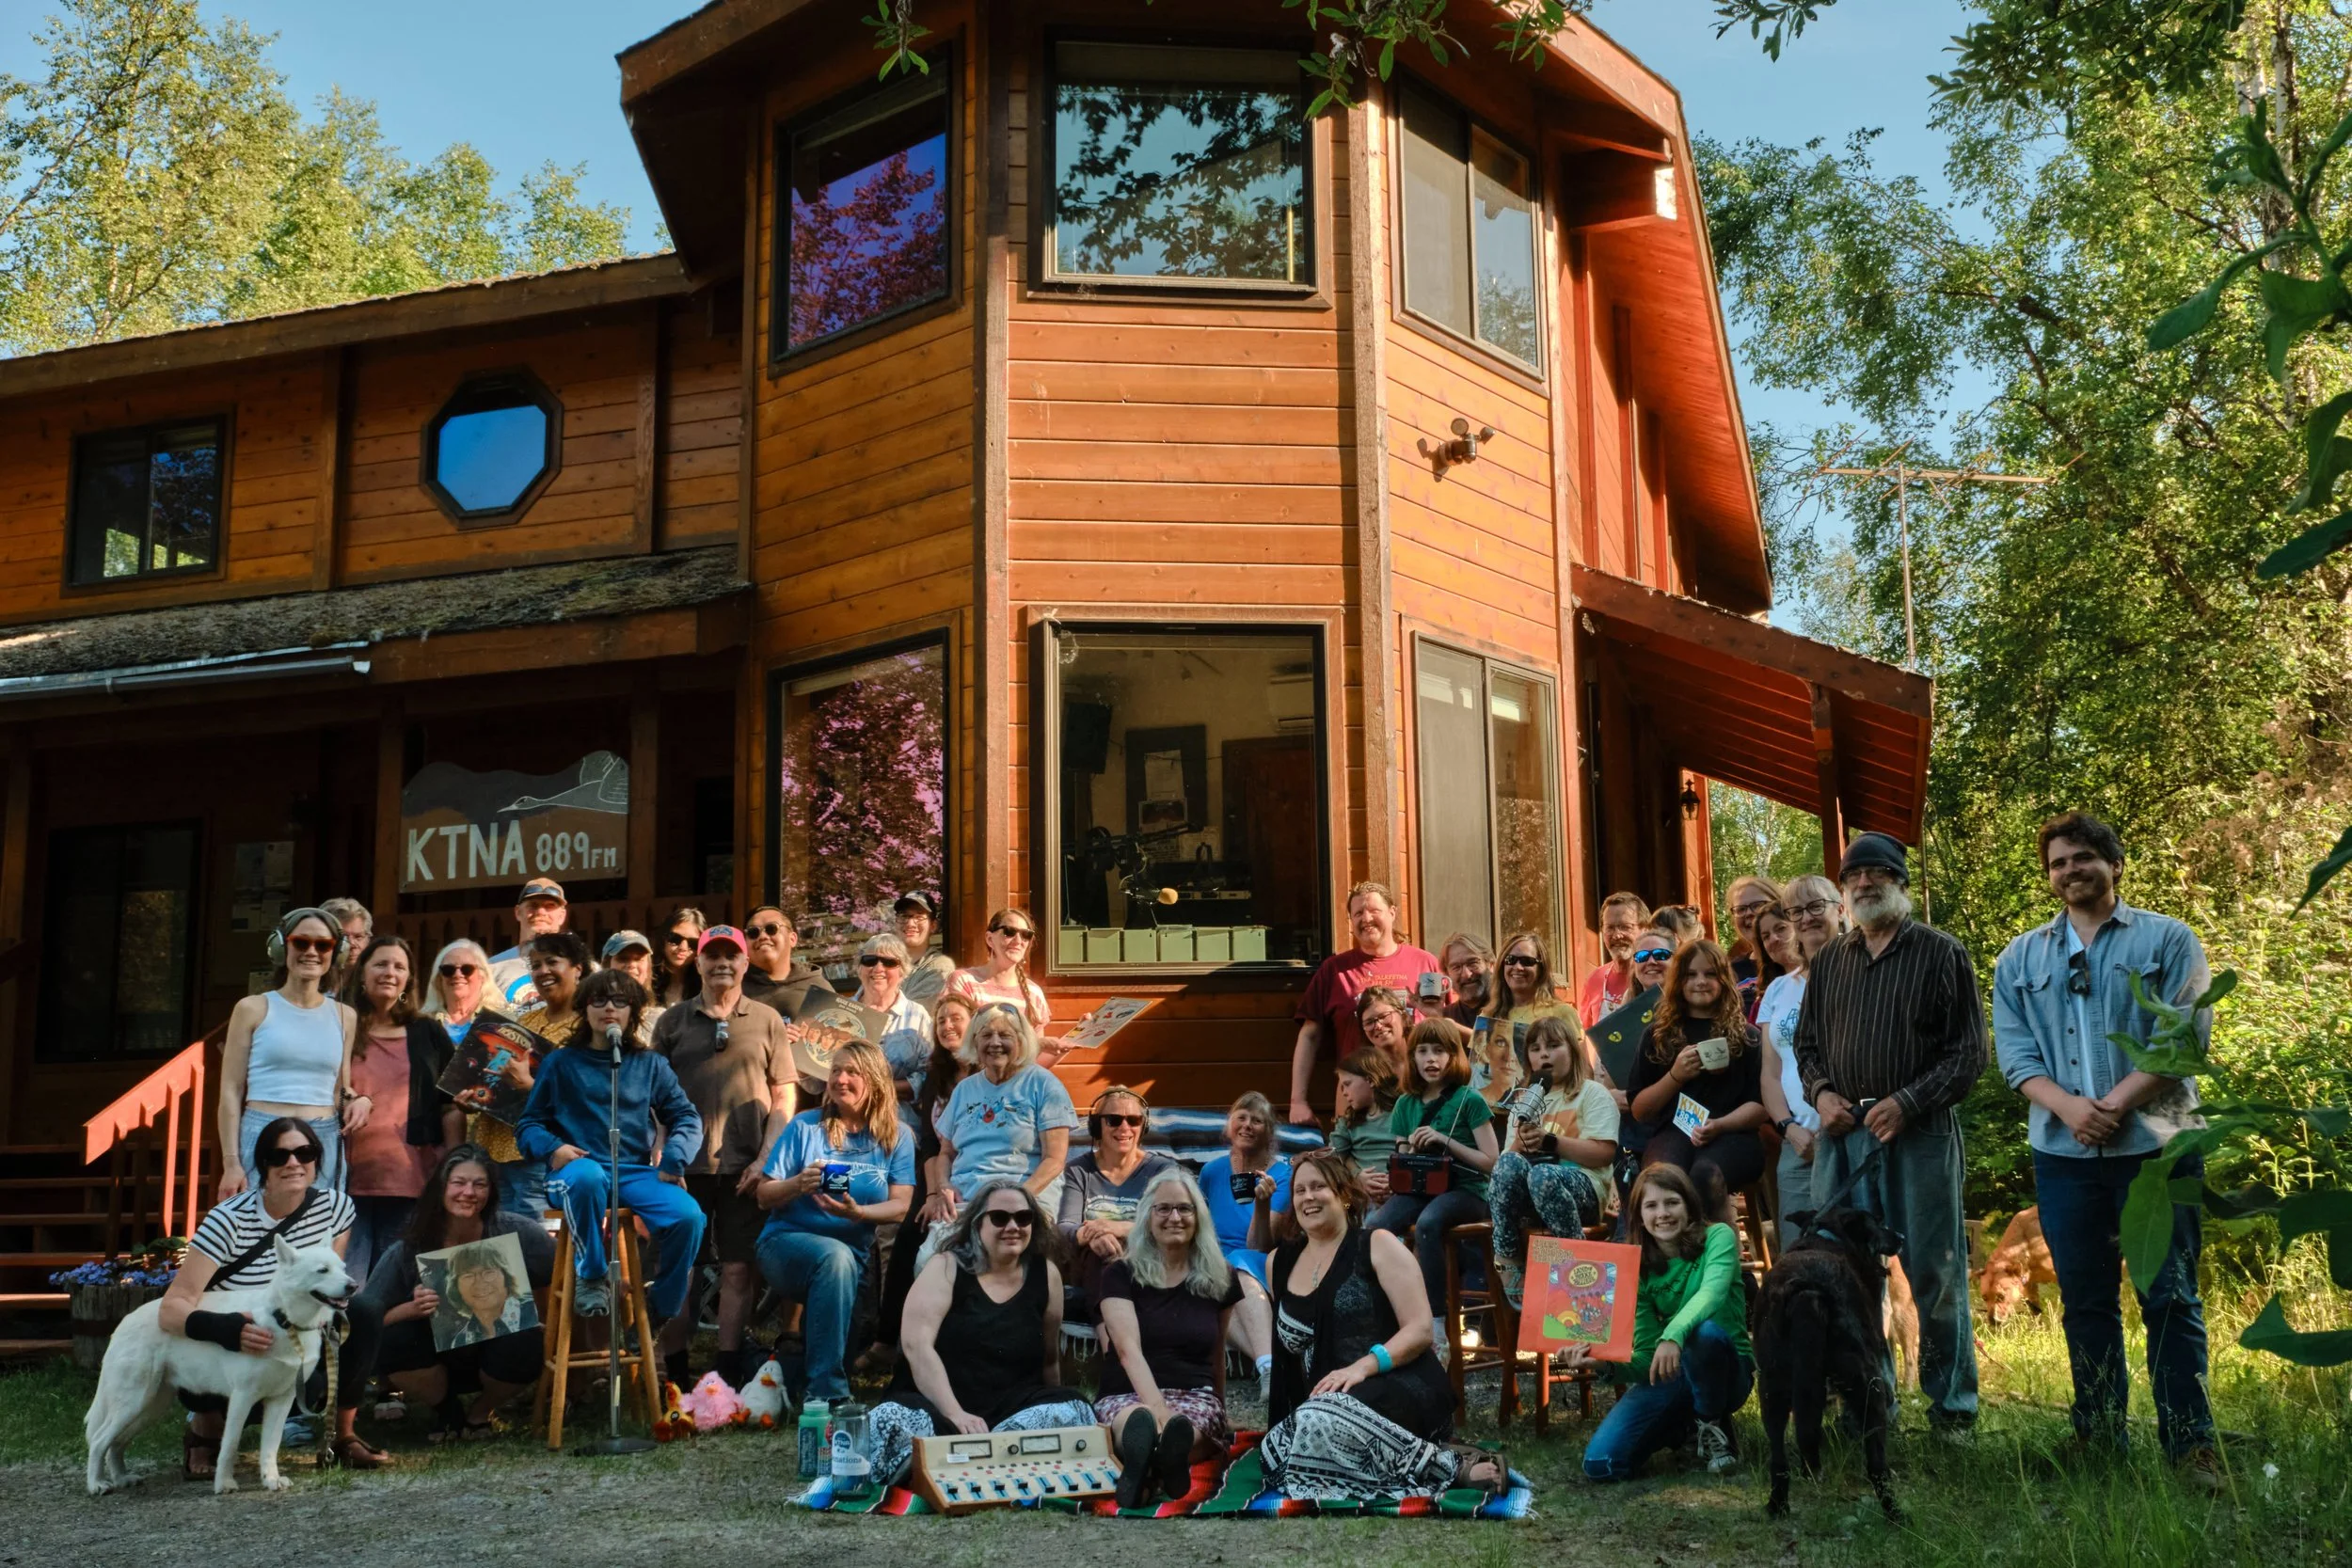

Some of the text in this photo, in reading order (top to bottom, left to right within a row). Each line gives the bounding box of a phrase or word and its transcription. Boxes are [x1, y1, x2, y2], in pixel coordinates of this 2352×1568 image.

[407, 819, 527, 881] KTNA
[591, 847, 617, 868] FM
[497, 1026, 532, 1051] BOSTON
[1678, 1111, 1695, 1128] 88.9
[1680, 1097, 1705, 1121] KTNA
